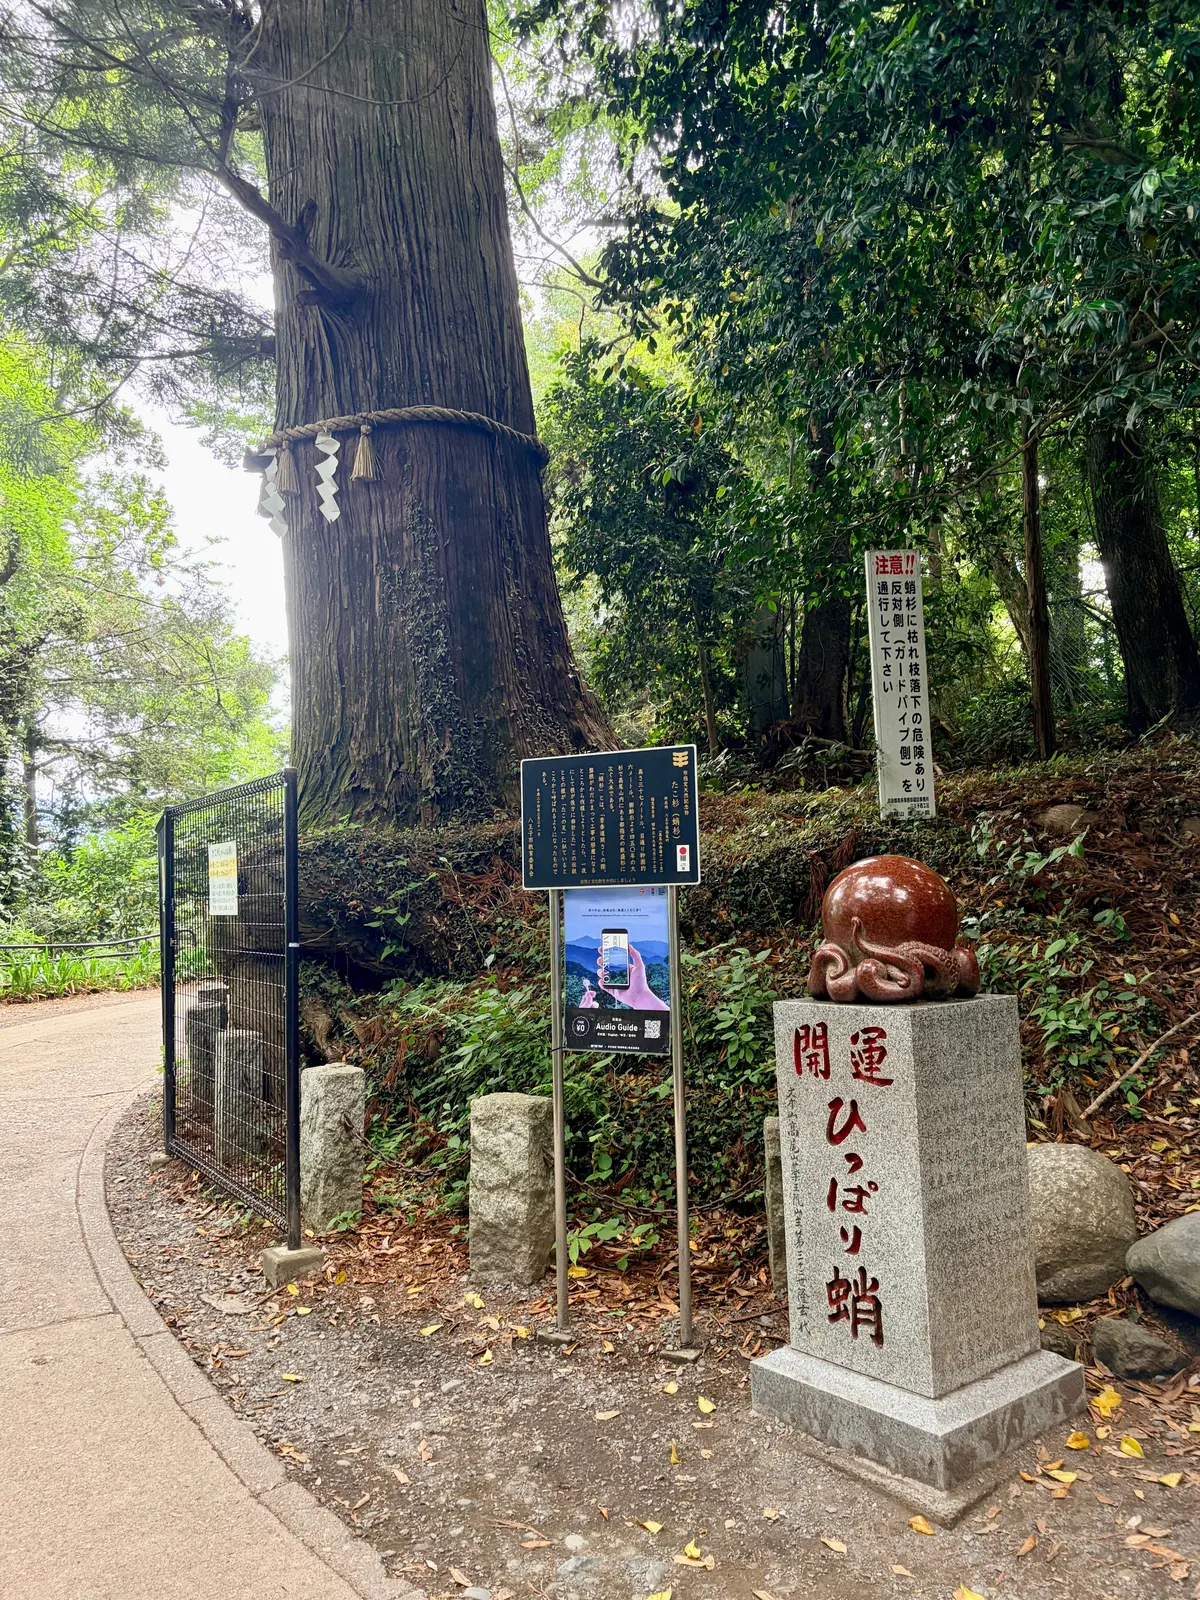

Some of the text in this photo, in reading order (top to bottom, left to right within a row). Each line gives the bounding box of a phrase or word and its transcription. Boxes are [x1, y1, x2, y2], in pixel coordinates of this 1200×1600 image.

[877, 581, 894, 693] 通行して下さい
[904, 580, 925, 792] 蛸杉に枯れ枝落下の危険あり
[576, 1024, 585, 1032] ¥0
[596, 1023, 638, 1032] Audio Guide
[825, 1096, 885, 1350] ひっぱり蛸
